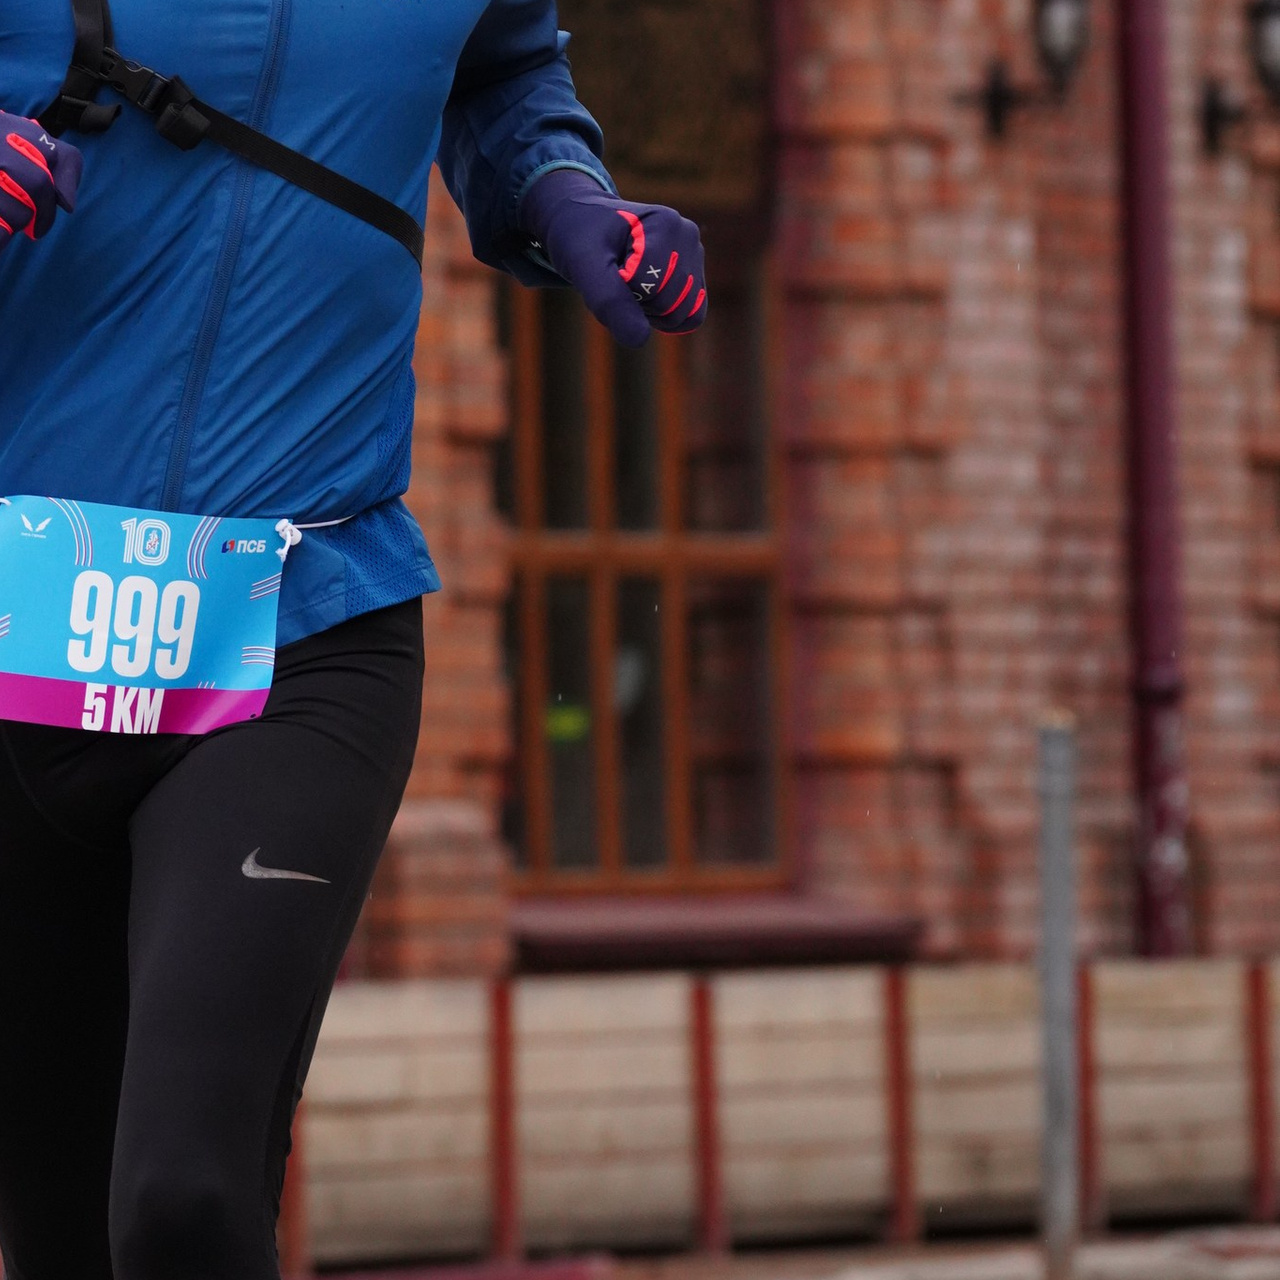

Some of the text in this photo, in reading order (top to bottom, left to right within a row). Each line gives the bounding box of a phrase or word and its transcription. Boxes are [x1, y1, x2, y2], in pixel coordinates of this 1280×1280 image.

[120, 517, 171, 566] 10
[236, 539, 267, 553] ПСБ
[67, 570, 200, 680] 999
[82, 683, 107, 732] 5
